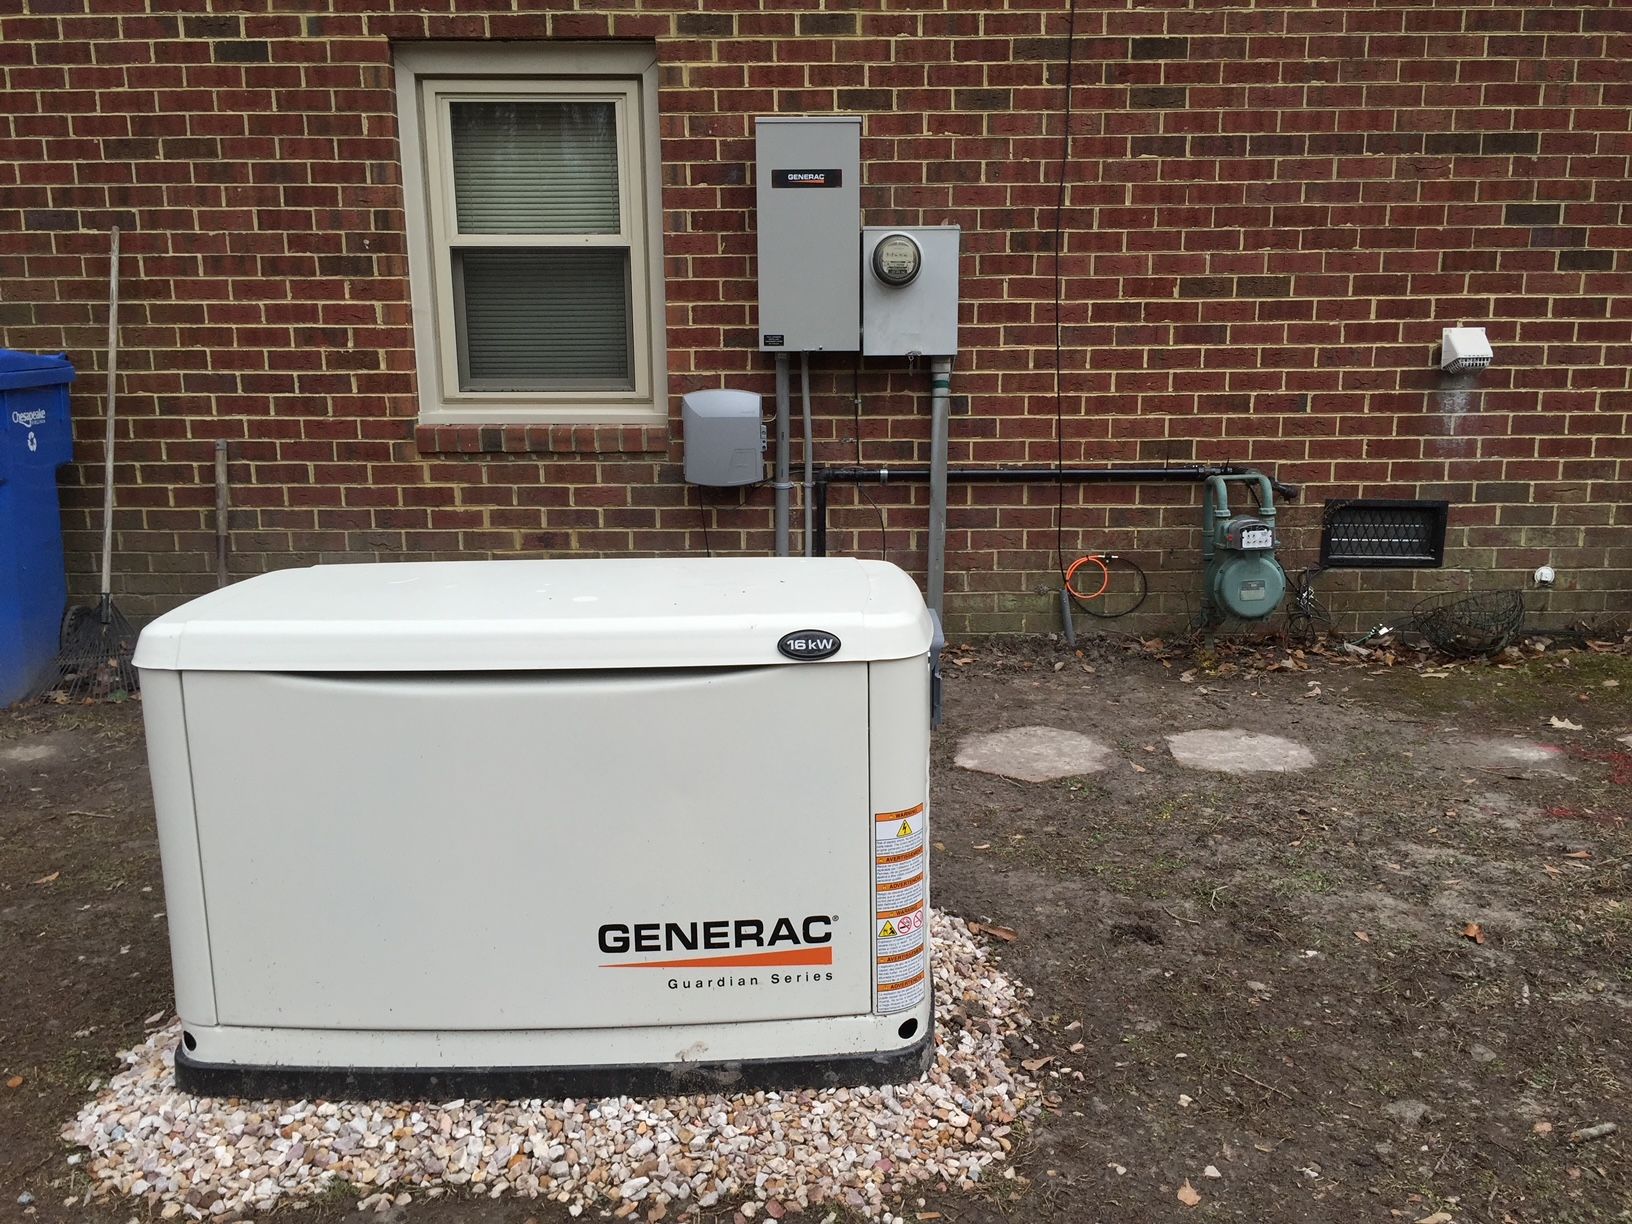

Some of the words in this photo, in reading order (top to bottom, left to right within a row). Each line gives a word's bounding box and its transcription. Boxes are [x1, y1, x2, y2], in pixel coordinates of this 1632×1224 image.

[787, 639, 807, 650] 16
[808, 638, 834, 650] kW
[886, 848, 922, 863] AVERTISSE
[887, 947, 922, 962] AVERTISSEM
[668, 975, 759, 990] Guardian
[770, 971, 834, 985] Series
